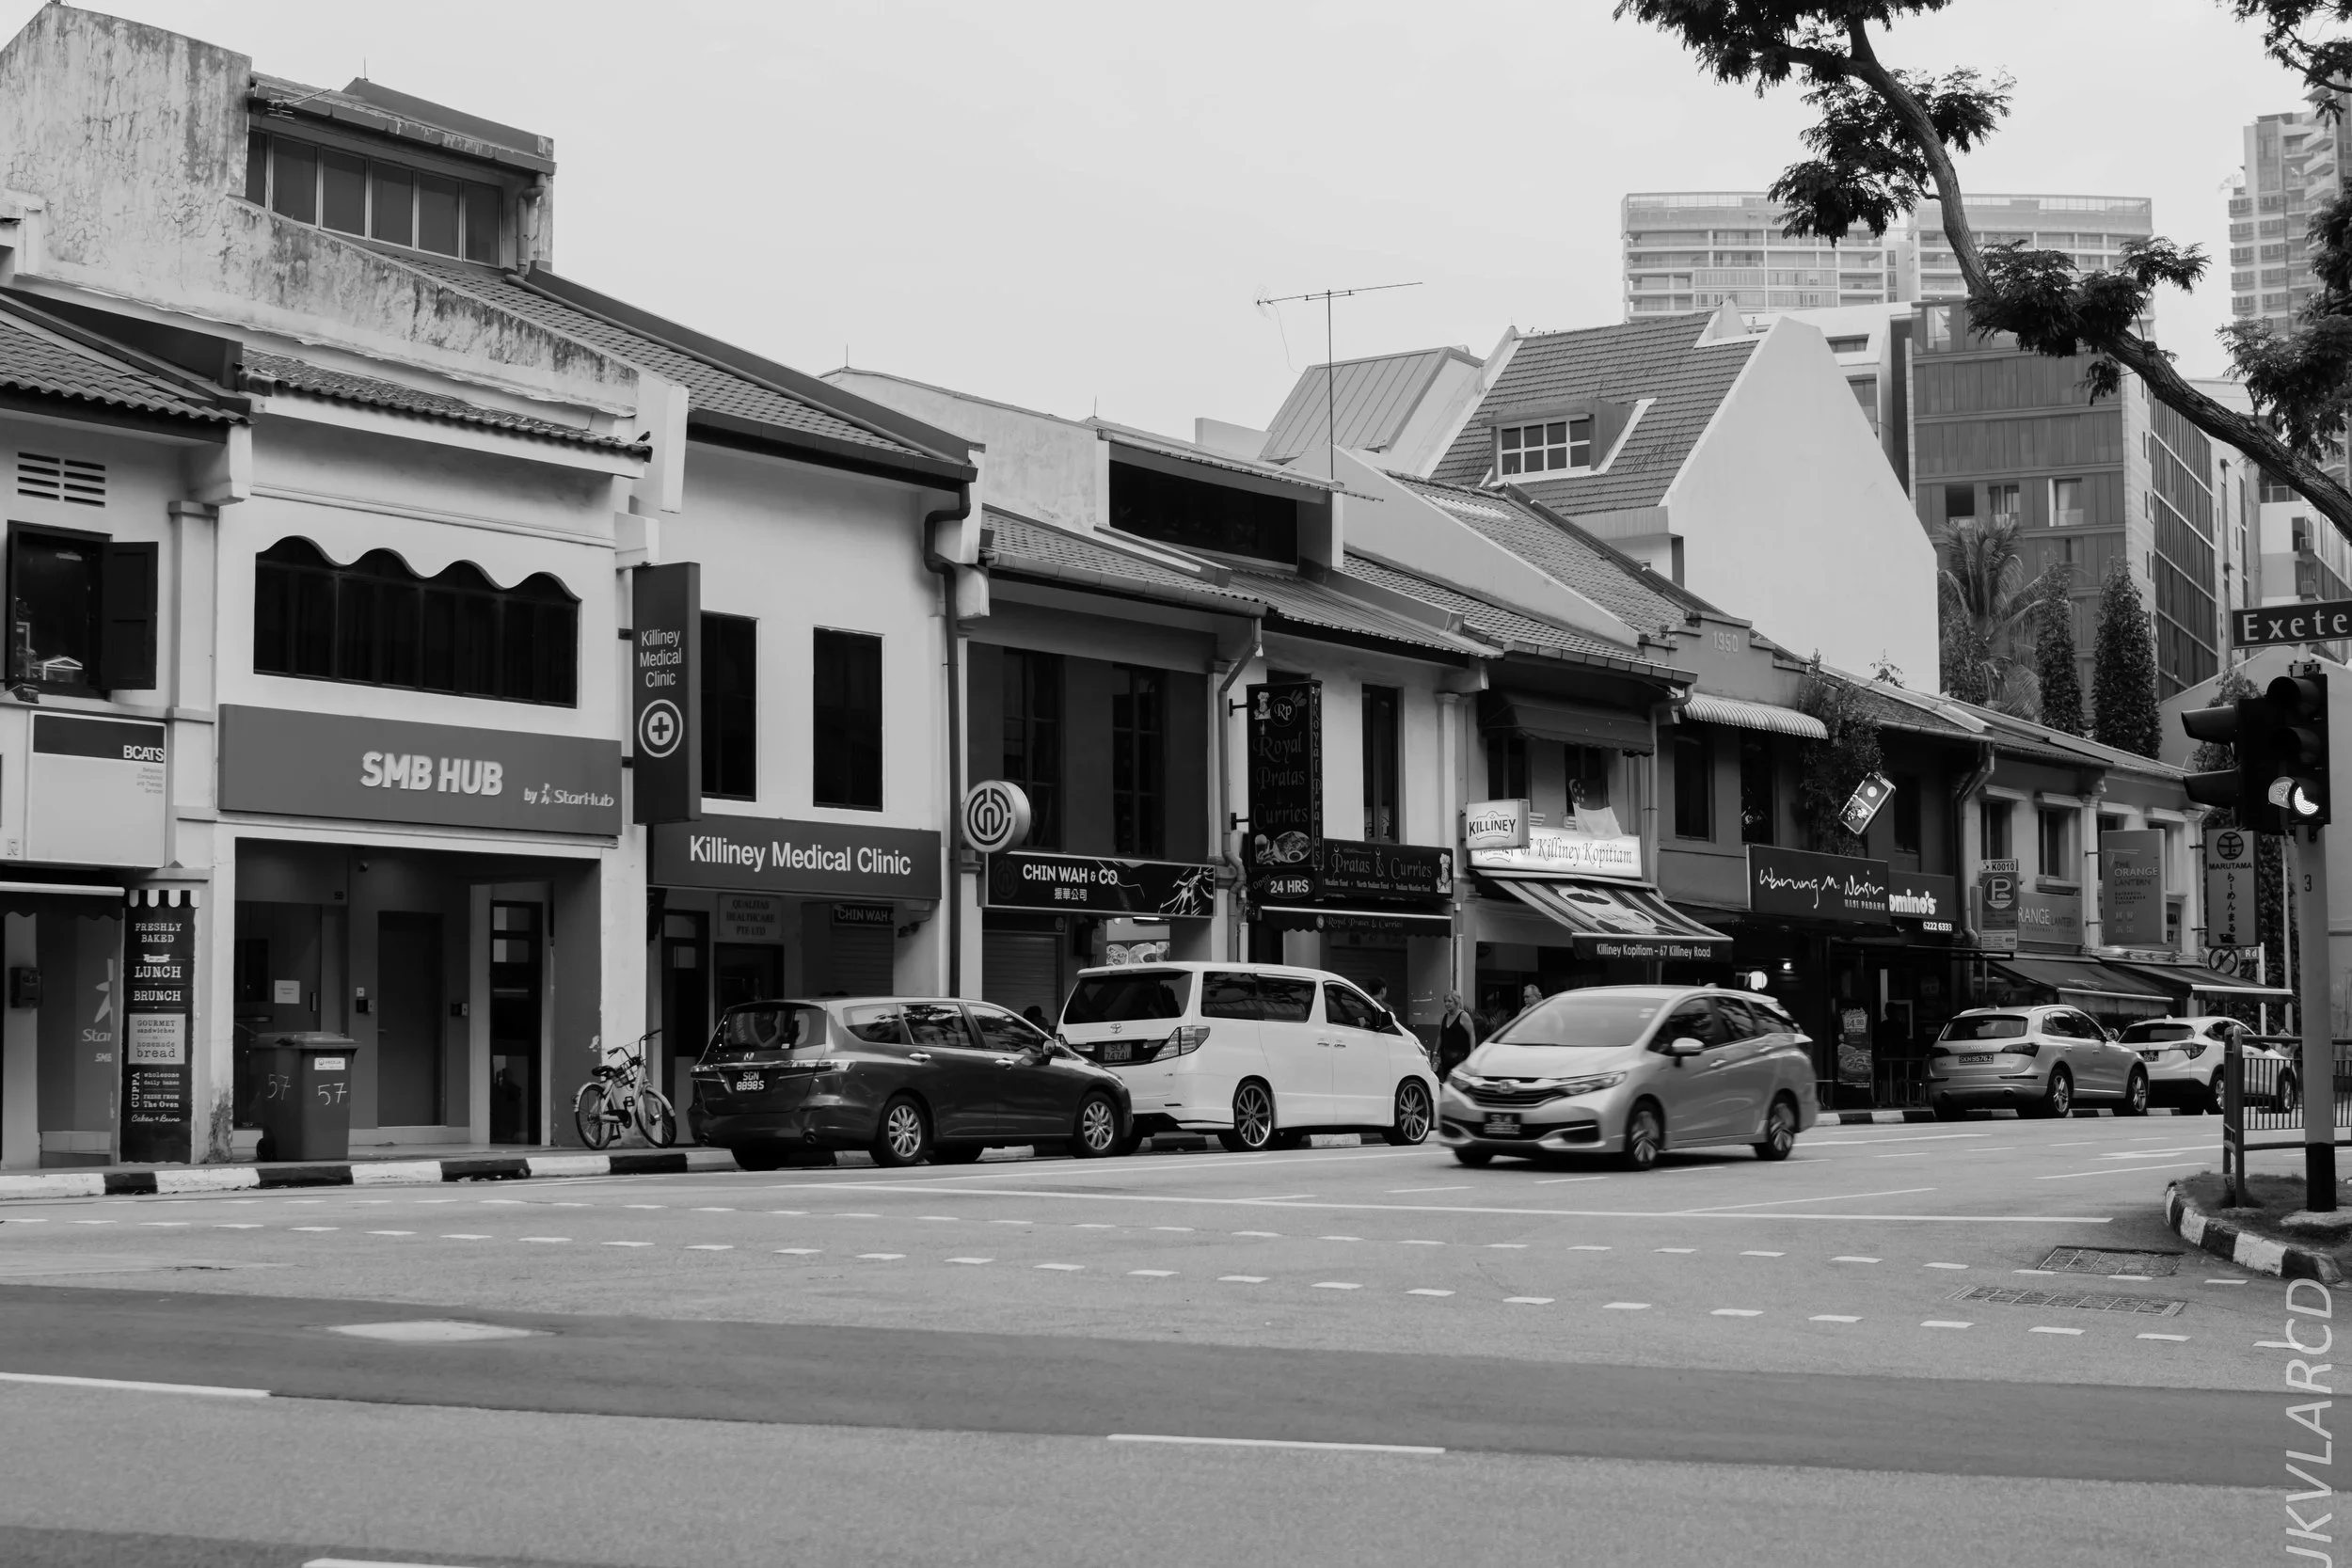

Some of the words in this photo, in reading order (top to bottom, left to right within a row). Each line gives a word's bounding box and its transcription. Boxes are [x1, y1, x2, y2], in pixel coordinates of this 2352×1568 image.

[2243, 610, 2348, 641] Exete
[641, 629, 681, 647] Killiney
[640, 647, 683, 668] Medical
[645, 670, 676, 688] Clinic
[123, 744, 164, 762] BCATS
[1252, 731, 1303, 764] Royal
[359, 751, 434, 791] SMB
[437, 756, 503, 797] HUB
[1256, 767, 1306, 790] Pratas
[523, 787, 538, 804] by
[553, 788, 614, 807] StarHub
[1253, 802, 1309, 831] Curries
[1469, 818, 1517, 837] KILLINEY
[690, 834, 766, 873] Killiney
[771, 841, 851, 872] Medical
[857, 847, 912, 875] Clinic
[1537, 837, 1581, 866] Killiney
[1583, 843, 1633, 868] Kopitiam
[1023, 863, 1056, 881] CHIN
[1058, 866, 1088, 883] WAH
[1090, 871, 1096, 882] &
[1098, 869, 1118, 885] CO
[1330, 853, 1371, 878] Pratas
[1391, 857, 1432, 879] Curries
[2114, 866, 2158, 877] ORANGE
[1054, 887, 1088, 901] 振華公司
[1270, 880, 1284, 894] 24
[1287, 879, 1310, 894] HRS
[1760, 867, 1820, 910] Warung
[837, 908, 864, 920] CHIN
[866, 910, 888, 922] WAH
[135, 923, 183, 931] FRESHLY
[1923, 921, 1938, 931] 6222
[1938, 923, 1952, 932] 6333
[141, 934, 175, 942] BAKED
[1597, 943, 1622, 958] Killiney
[1660, 945, 1667, 956] 67
[1669, 945, 1692, 958] Killiney
[1693, 946, 1711, 958] Road
[2245, 949, 2257, 958] Rd
[134, 966, 182, 978] LUNCH
[133, 990, 182, 1001] BRUNCH
[136, 1048, 176, 1058] bread
[742, 1071, 759, 1081] SGN
[132, 1072, 140, 1108] CUPPA
[267, 1073, 291, 1101] 57
[318, 1083, 347, 1105] 57
[736, 1080, 765, 1091] 8898S
